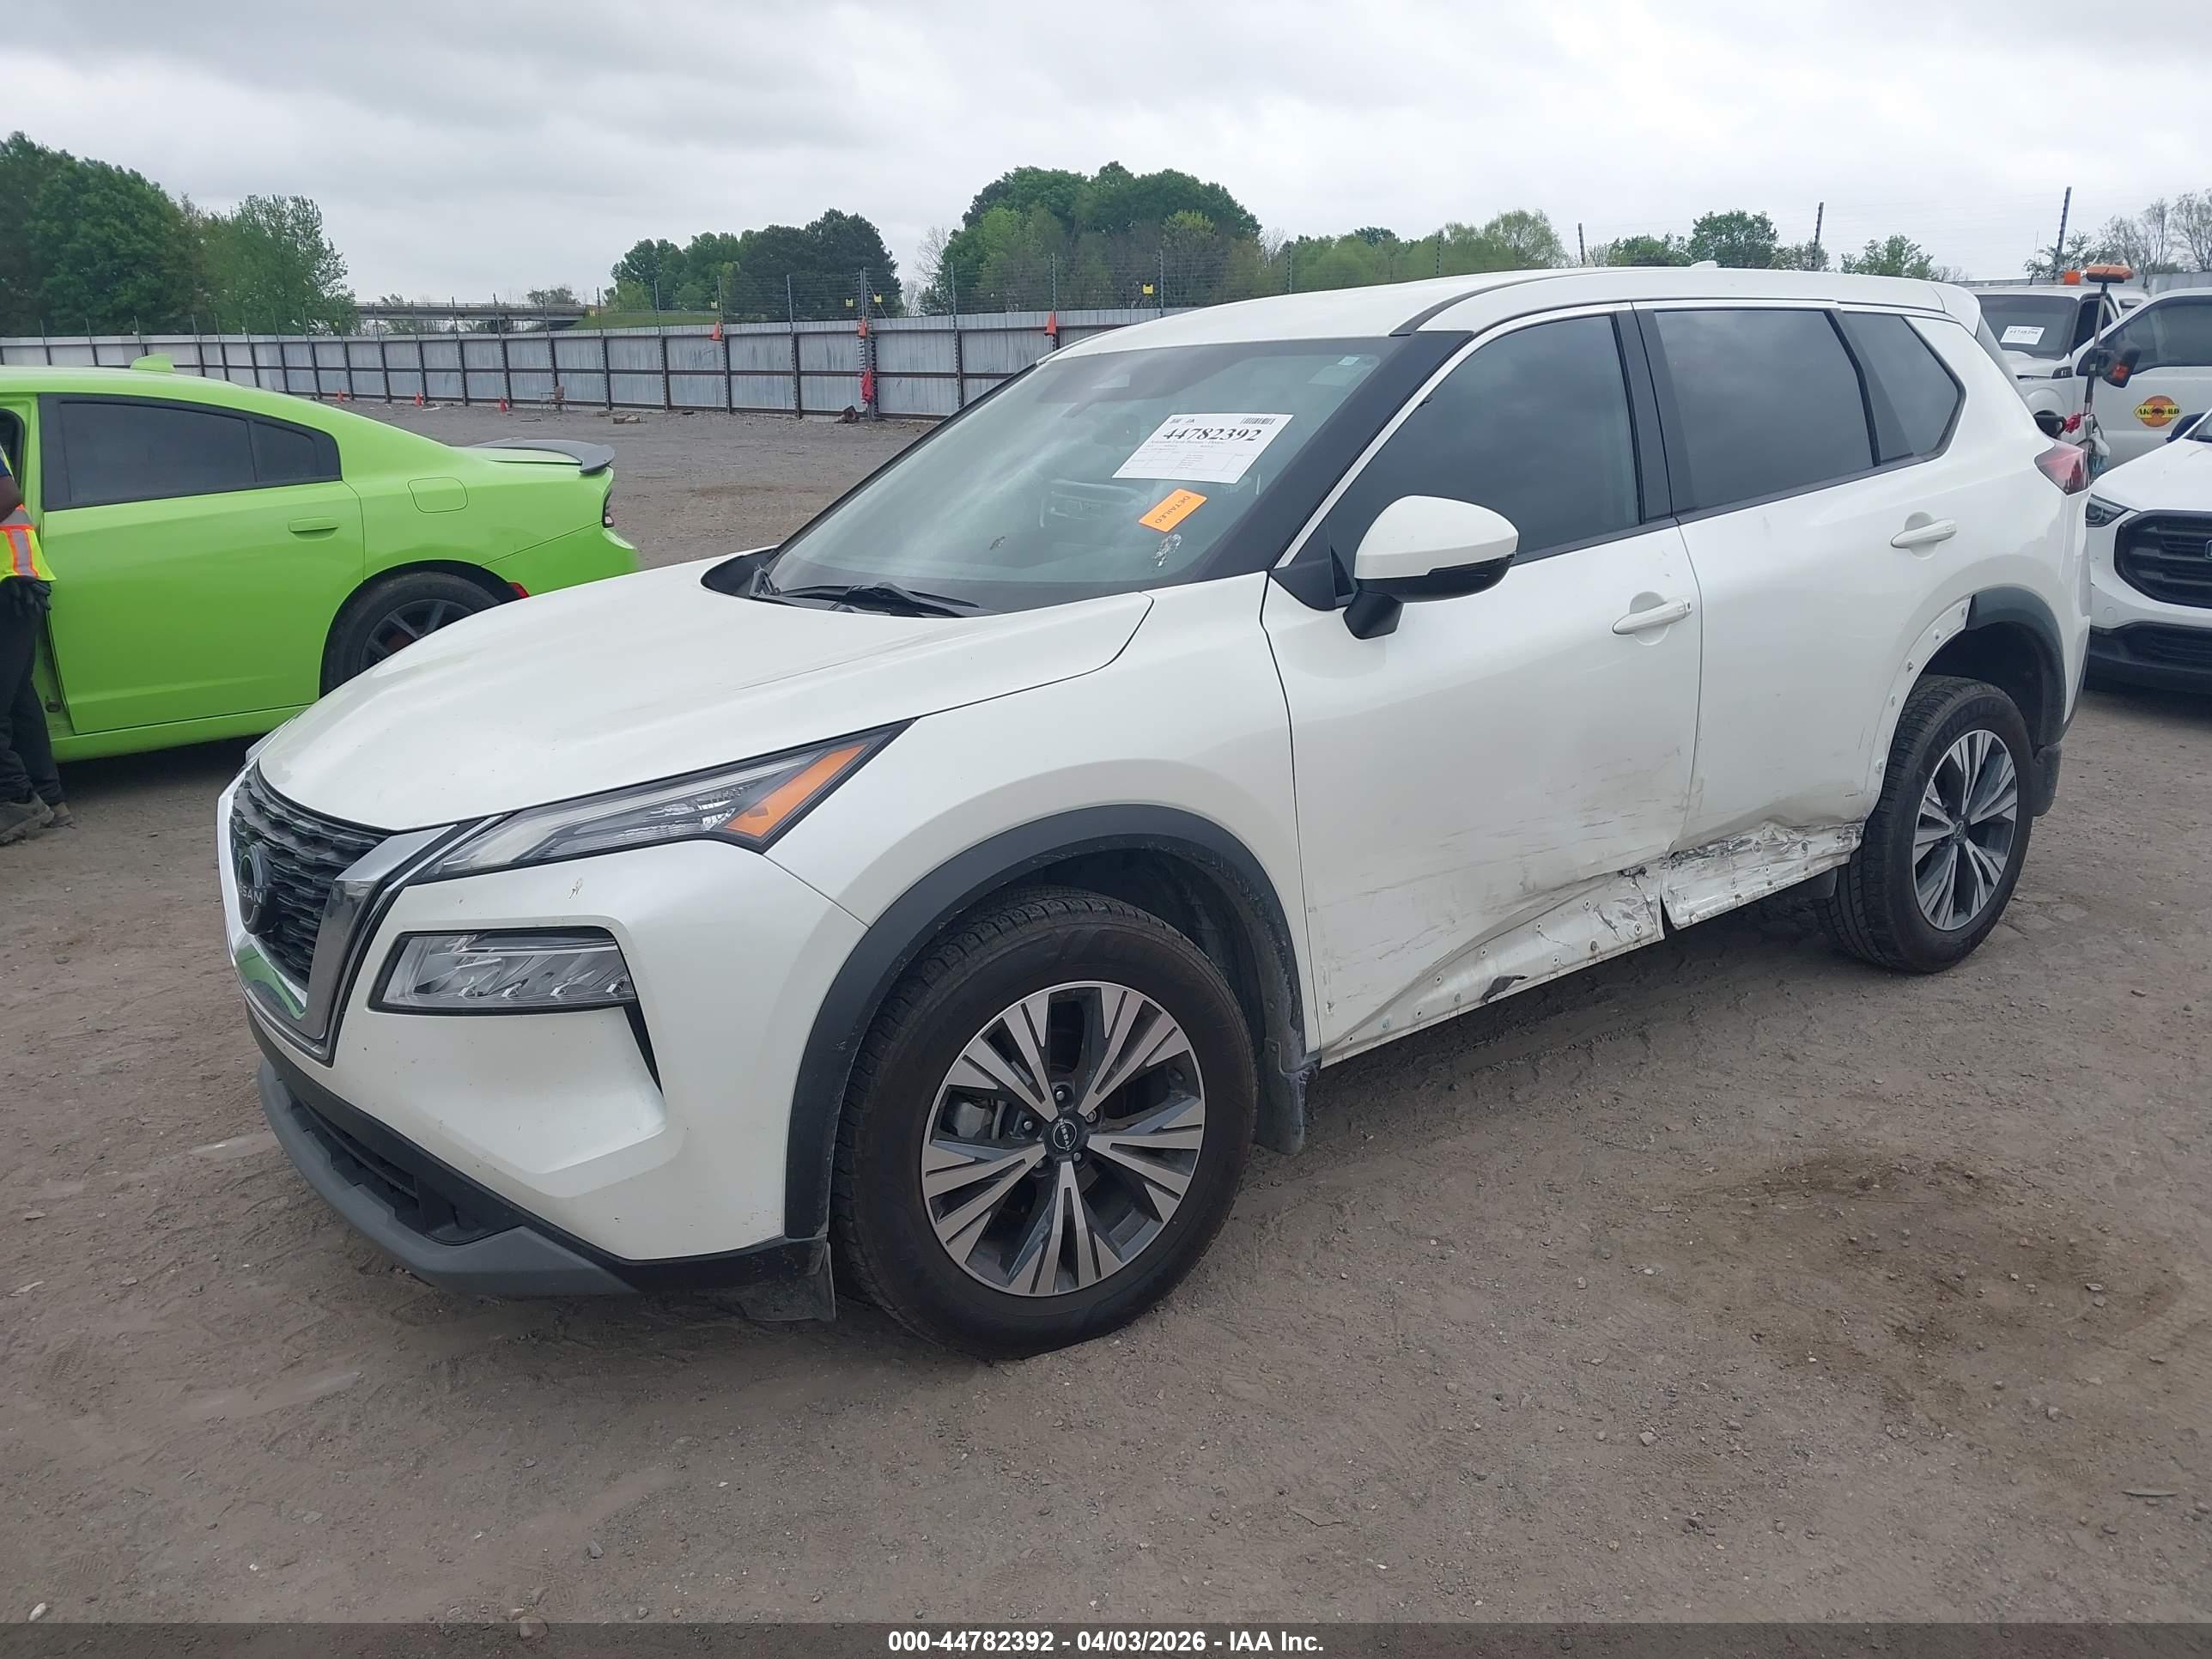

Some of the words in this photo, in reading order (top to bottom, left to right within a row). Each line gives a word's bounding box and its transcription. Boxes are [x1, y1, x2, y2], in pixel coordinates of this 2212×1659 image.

[1164, 428, 1262, 441] 44782392
[1154, 495, 1190, 524] DETAILED
[1058, 1118, 1073, 1152] NISSAN
